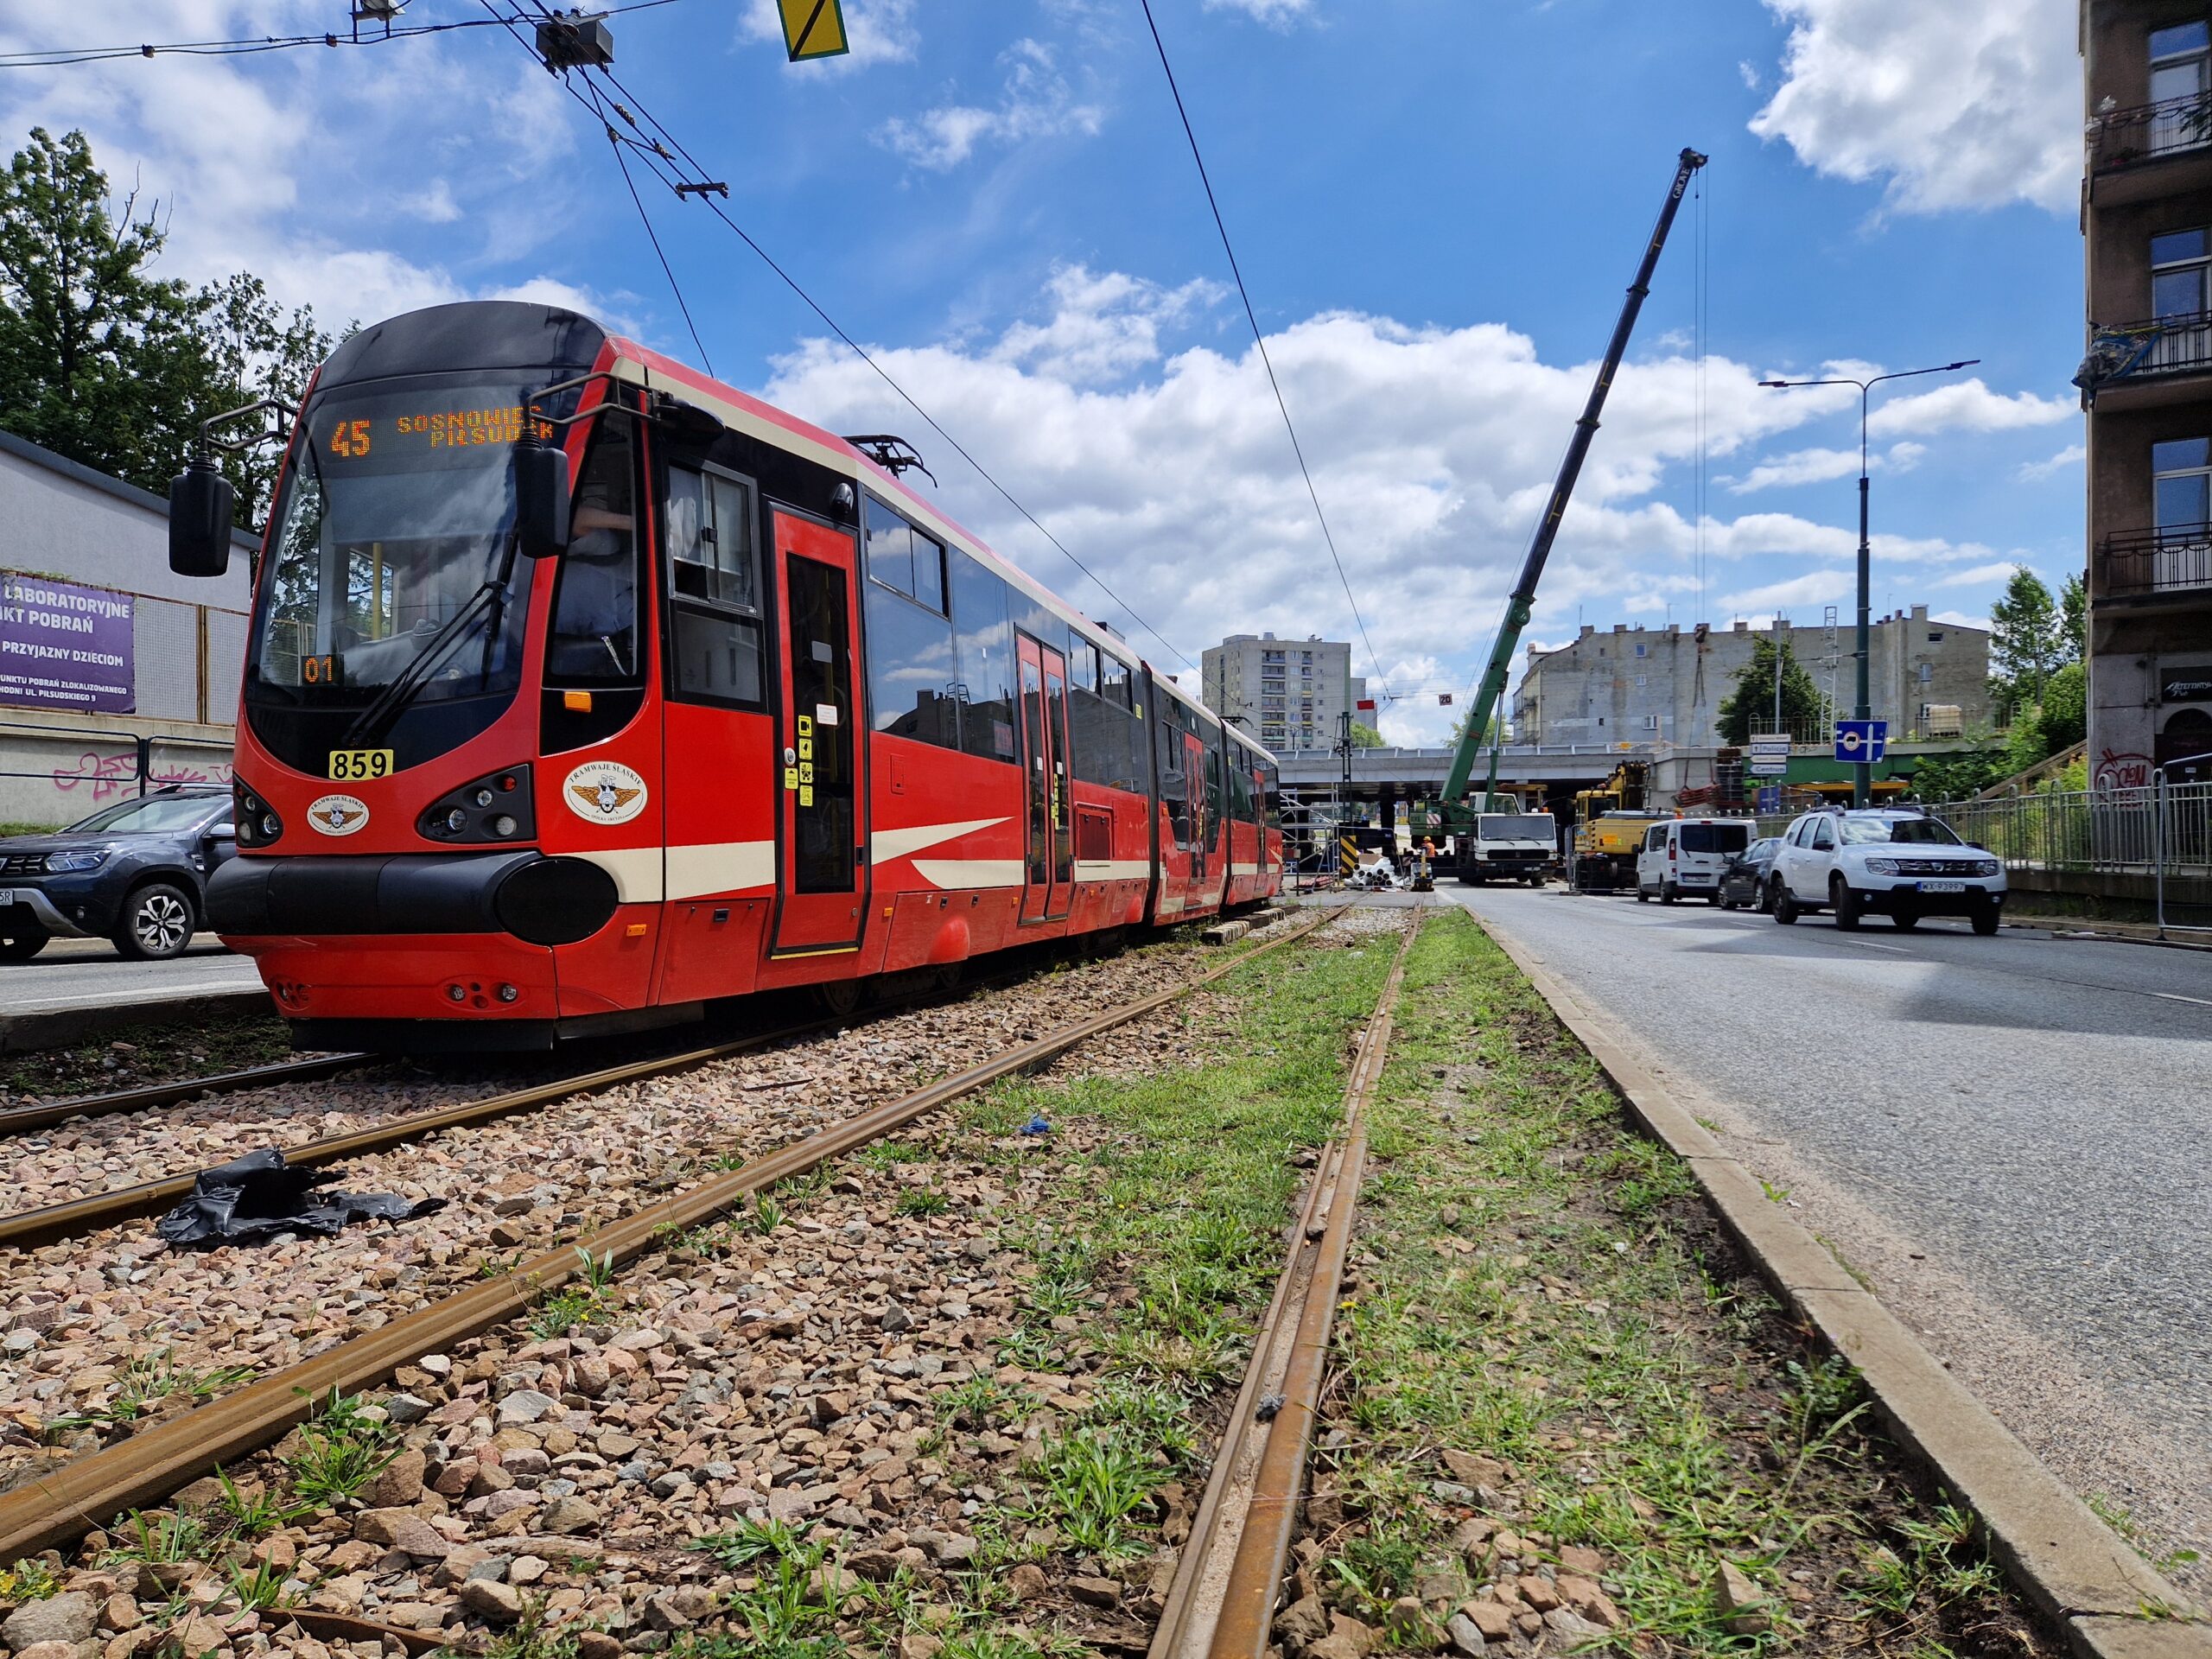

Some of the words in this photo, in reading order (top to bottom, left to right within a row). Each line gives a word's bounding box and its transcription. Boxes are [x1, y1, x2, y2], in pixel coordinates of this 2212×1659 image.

[1673, 167, 1690, 199] GROVE
[331, 419, 372, 457] 45
[4, 585, 130, 619] LABORATORYJNE
[29, 609, 93, 633] POBRAŃ
[2, 641, 70, 659] PRZYJAZNY
[73, 650, 124, 666] DZIECIOM
[305, 657, 332, 683] 01
[29, 678, 60, 688] POBRAŃ
[1440, 696, 1452, 704] 20
[334, 752, 387, 779] 859
[569, 764, 611, 783] TRAMWAJE
[612, 763, 642, 785] ŚLĄSKIE
